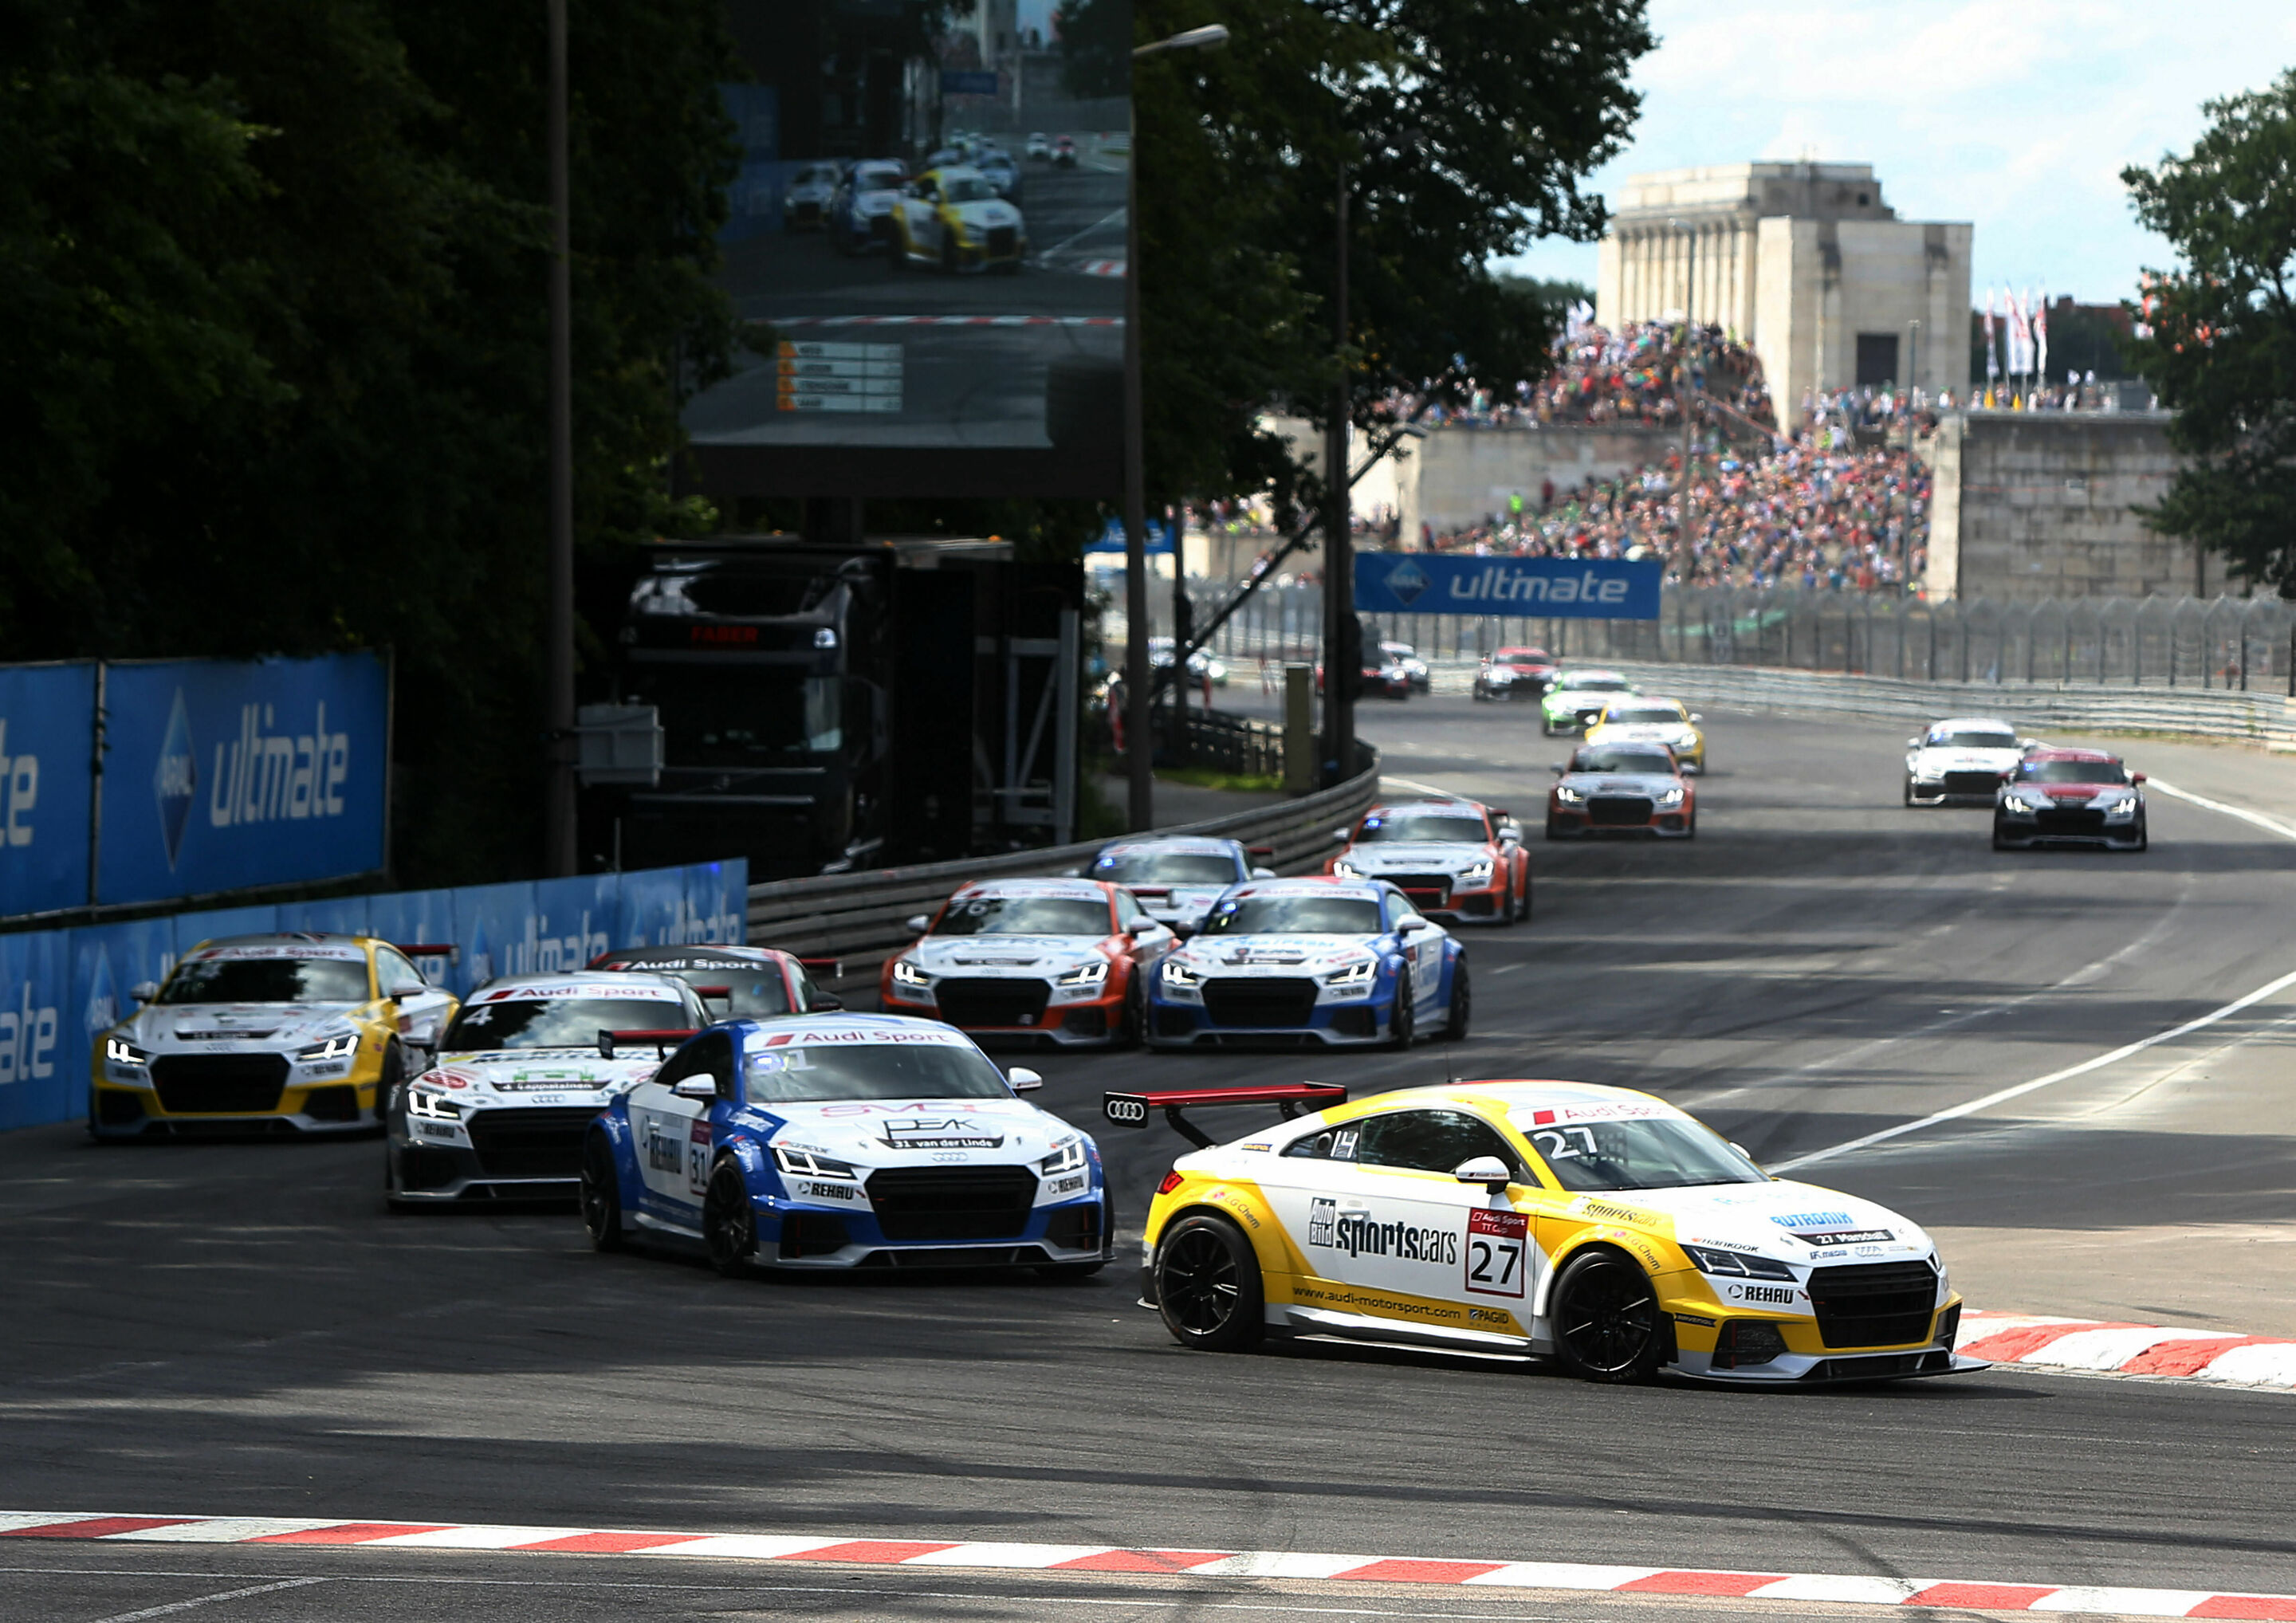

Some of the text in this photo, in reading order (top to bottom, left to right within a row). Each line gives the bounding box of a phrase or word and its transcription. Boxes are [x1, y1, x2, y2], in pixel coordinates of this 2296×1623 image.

[1449, 566, 1629, 603] ultimate
[210, 699, 348, 827] ultimate
[631, 957, 763, 971] Audi Sport
[521, 987, 663, 997] Audi Sport
[462, 1005, 493, 1026] 4
[803, 1031, 951, 1043] Audi Sport
[1564, 1105, 1618, 1119] Audi
[894, 1139, 910, 1148] 31
[940, 1139, 959, 1148] der
[960, 1138, 994, 1148] Linde
[1533, 1126, 1598, 1160] 27
[810, 1182, 855, 1201] REHAU
[1225, 1194, 1260, 1230] LG Chem
[1482, 1212, 1526, 1228] Audi Sport
[1480, 1223, 1508, 1235] TT Cup
[1336, 1217, 1457, 1265] sportscars
[1816, 1235, 1834, 1244] 27
[1625, 1235, 1661, 1271] LG Chem
[1470, 1240, 1520, 1285] 27
[1292, 1286, 1461, 1320] www.audi-motorsport.com
[1745, 1287, 1795, 1305] REHAU
[1478, 1309, 1509, 1325] PAGID
